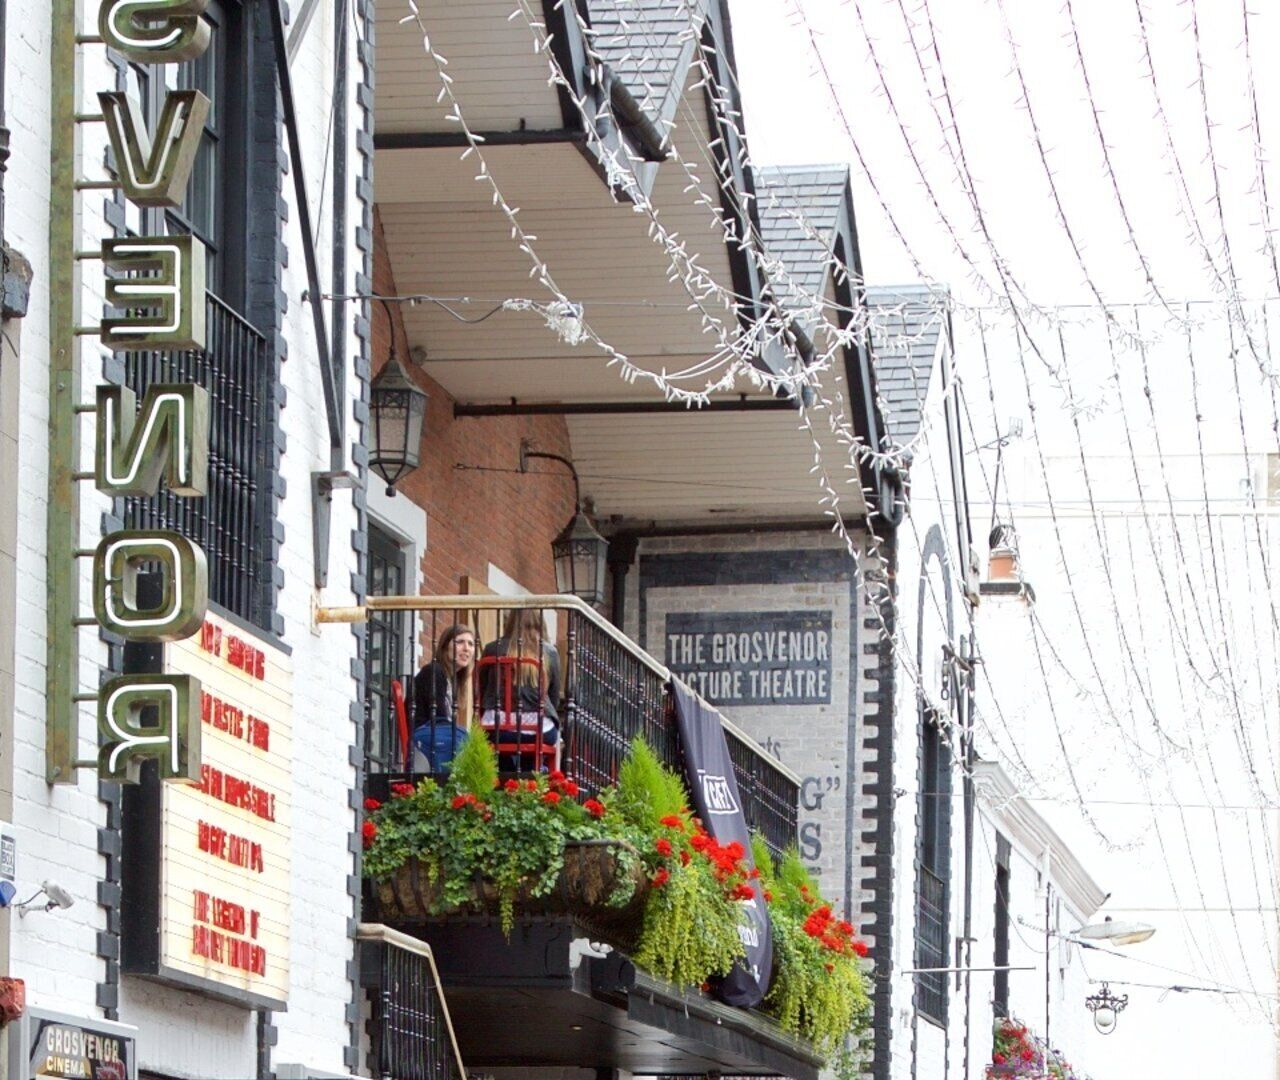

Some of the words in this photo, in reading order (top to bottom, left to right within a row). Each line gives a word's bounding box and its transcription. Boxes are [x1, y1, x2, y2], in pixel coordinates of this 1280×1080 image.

[668, 633, 707, 665] THE
[711, 630, 830, 664] GROSVENOR
[748, 669, 828, 699] THEATRE
[46, 1025, 120, 1063] GROSVENOR
[46, 1055, 86, 1077] CINEMA
